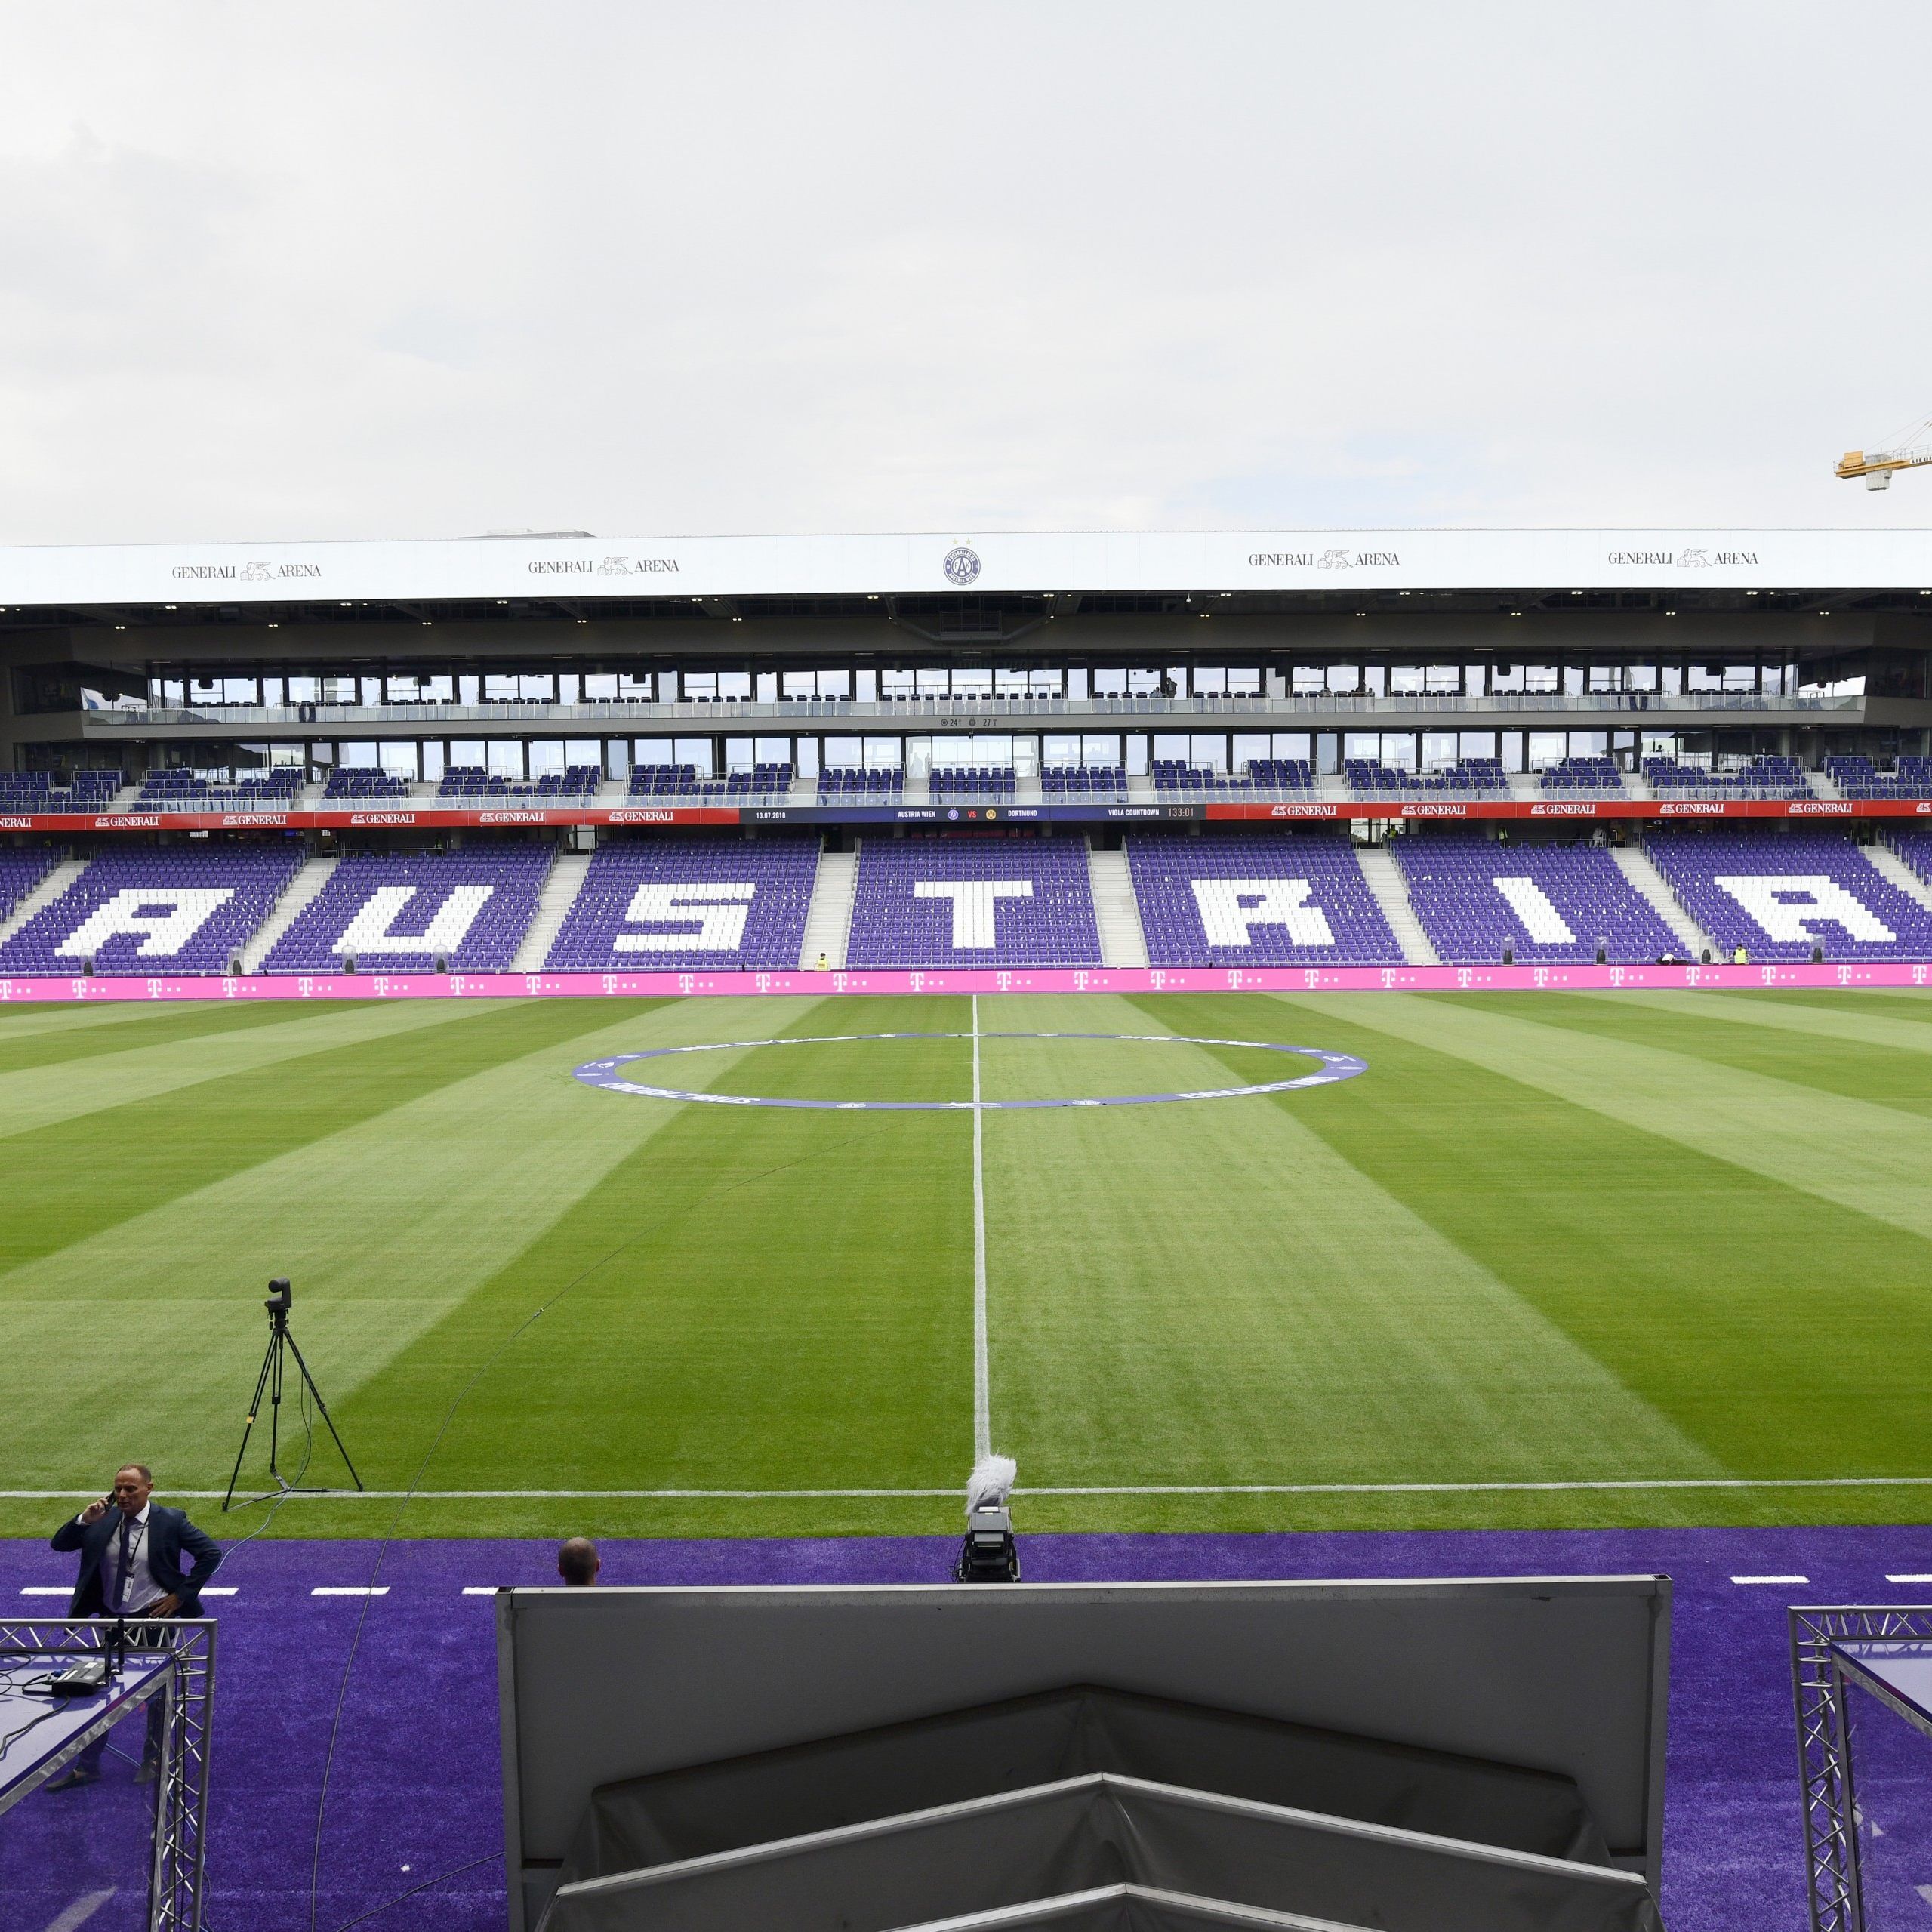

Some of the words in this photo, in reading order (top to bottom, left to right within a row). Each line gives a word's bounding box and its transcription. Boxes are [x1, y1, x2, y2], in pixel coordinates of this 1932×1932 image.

[1249, 554, 1312, 565] GENERALI
[1355, 553, 1400, 565] ARENA
[1609, 553, 1672, 564] GENERALI
[1714, 553, 1758, 564] ARENA
[173, 566, 235, 578] GENERALI
[278, 565, 321, 576] ARENA
[529, 561, 591, 573] GENERALI
[635, 560, 679, 572] ARENA
[1168, 808, 1194, 817] 133:01
[1286, 806, 1337, 816] GENERALI
[1416, 805, 1466, 815] GENERALI
[1546, 804, 1596, 815] GENERALI
[1675, 803, 1725, 814] GENERALI
[1804, 803, 1853, 813] GENERALI
[110, 816, 159, 827] GENERALI
[238, 815, 287, 825] GENERALI
[366, 813, 416, 824] GENERALI
[495, 812, 546, 823] GENERALI
[624, 811, 674, 821] GENERALI
